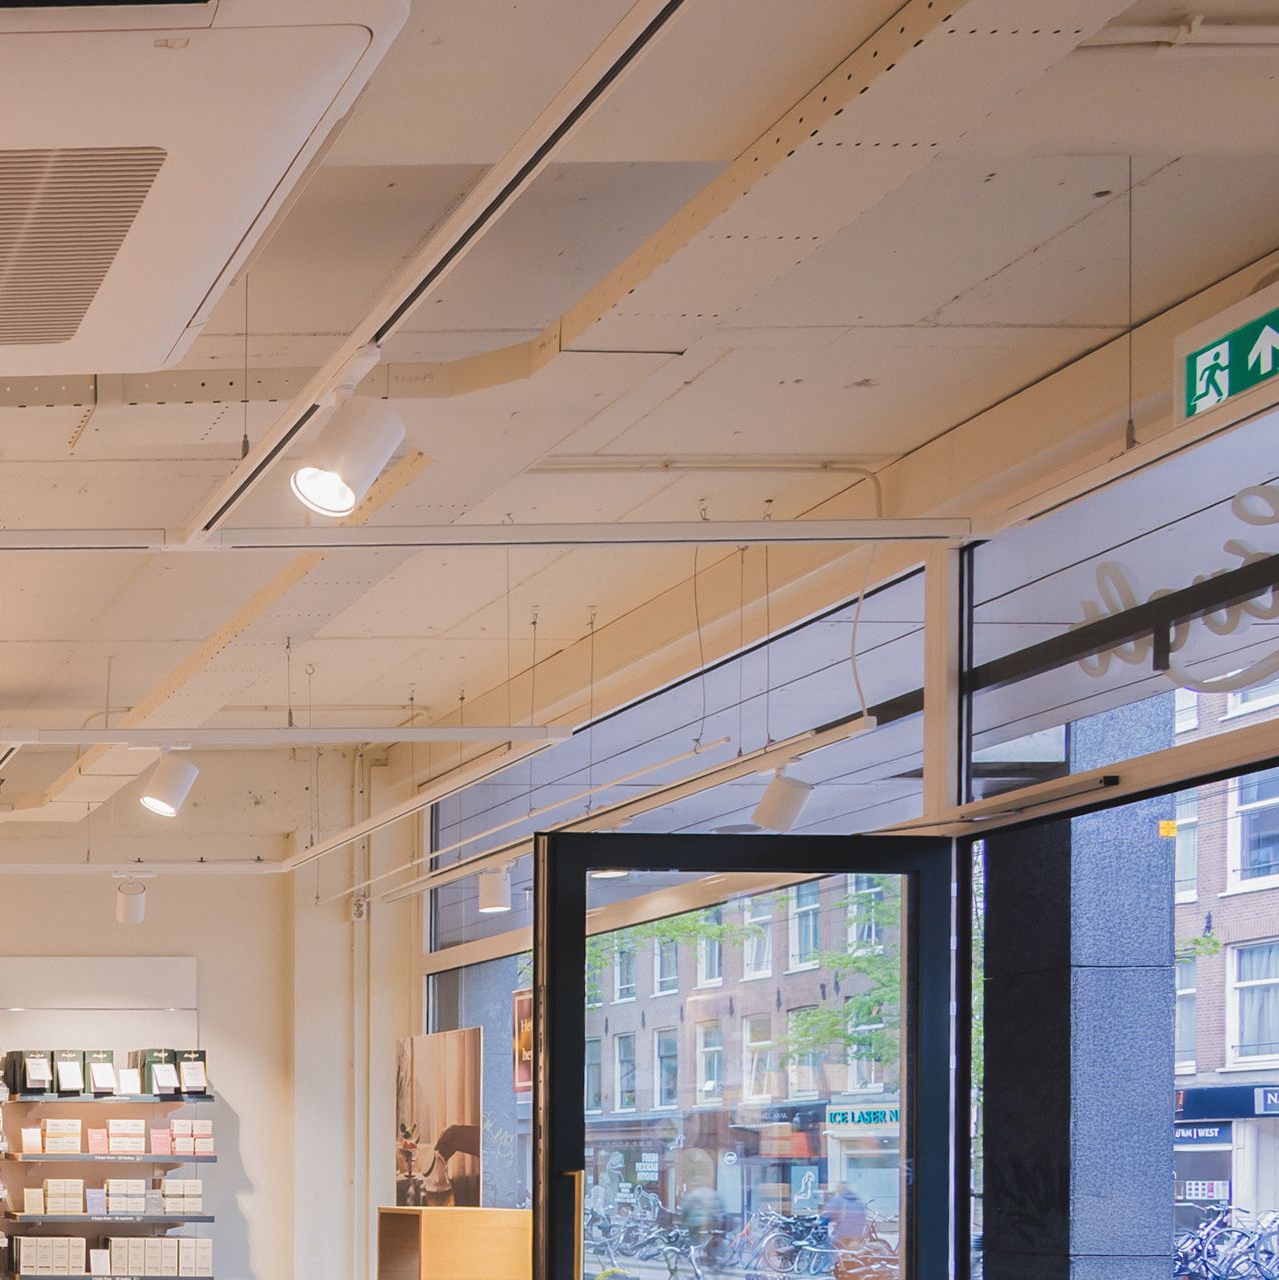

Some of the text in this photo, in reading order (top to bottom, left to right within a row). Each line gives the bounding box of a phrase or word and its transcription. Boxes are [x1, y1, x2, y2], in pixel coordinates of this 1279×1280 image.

[829, 1111, 849, 1124] ICE
[851, 1110, 887, 1124] LASER
[1197, 1128, 1220, 1138] WEST
